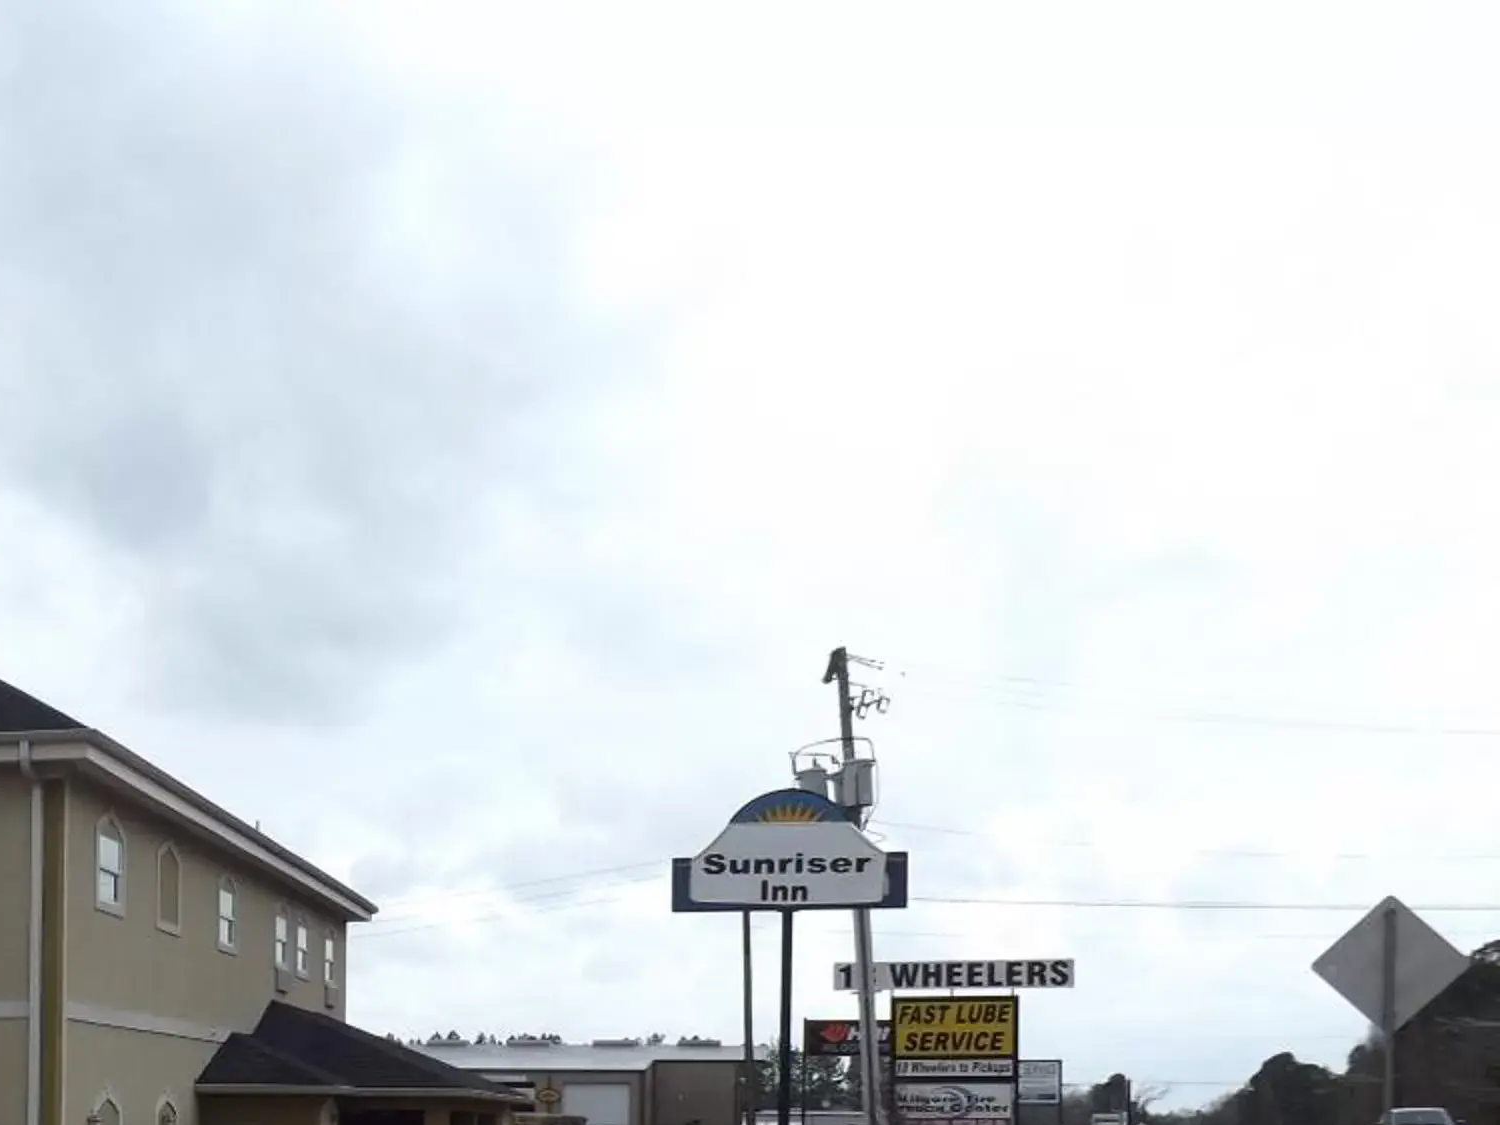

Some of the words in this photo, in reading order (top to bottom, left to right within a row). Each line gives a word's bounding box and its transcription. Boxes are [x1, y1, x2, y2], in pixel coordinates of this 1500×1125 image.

[703, 853, 871, 875] Sunriser
[760, 880, 808, 901] Inn
[838, 963, 876, 988] 1
[890, 960, 1069, 988] WHEELERS
[899, 1005, 953, 1025] FAST
[956, 1003, 1011, 1024] LUBE
[904, 1032, 1005, 1051] SERVICE
